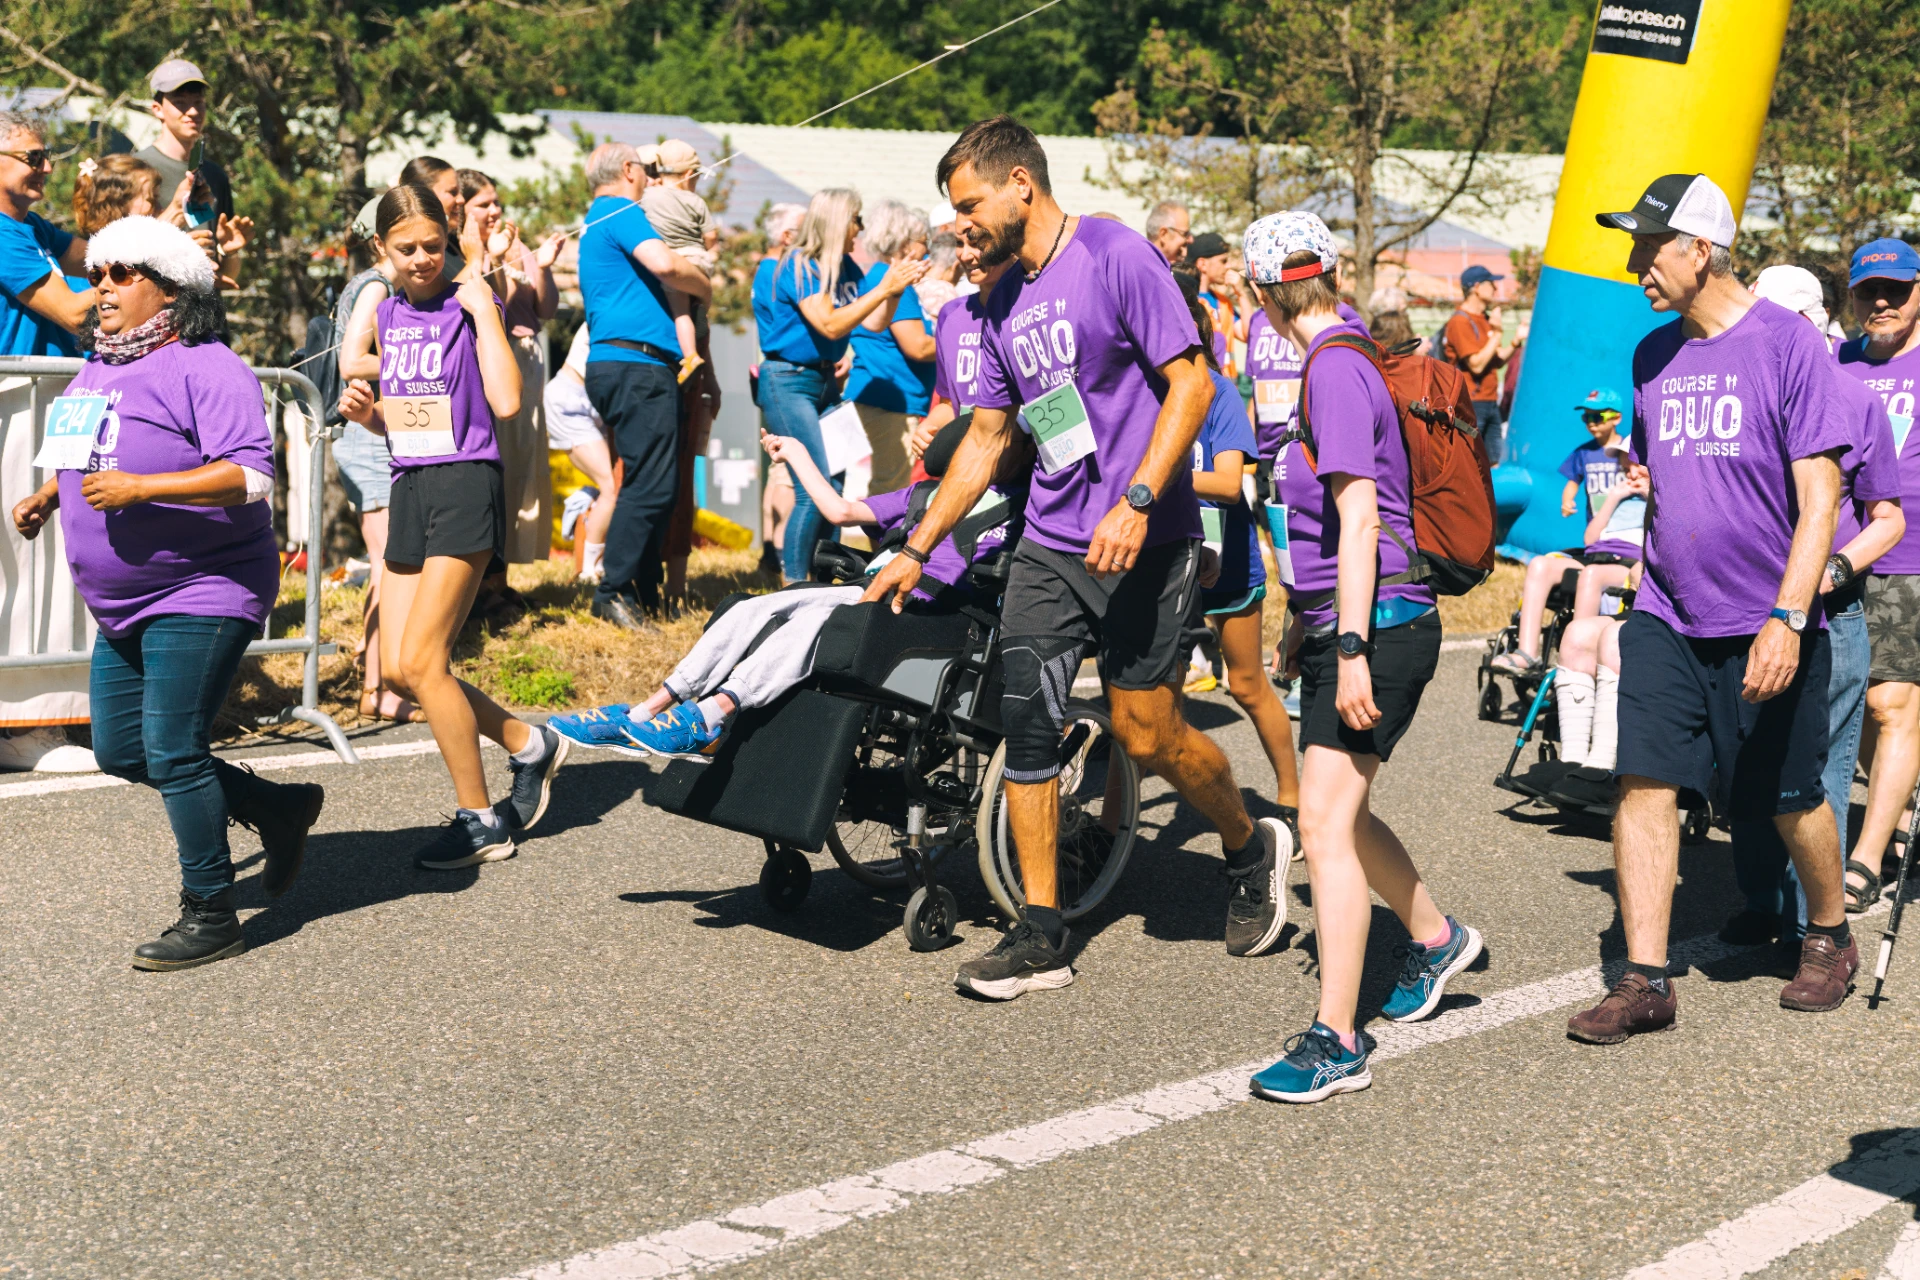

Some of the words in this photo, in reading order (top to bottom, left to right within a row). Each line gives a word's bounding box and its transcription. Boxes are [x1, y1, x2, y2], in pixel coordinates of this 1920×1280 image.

[1645, 194, 1669, 211] Thierry
[1861, 252, 1898, 266] procap
[1012, 301, 1049, 333] COURSE
[382, 342, 442, 380] DUO
[1012, 319, 1076, 379] DUO
[405, 380, 446, 394] SUISSE
[1265, 383, 1290, 403] 114
[1661, 374, 1717, 395] COURSE
[54, 403, 93, 434] 214
[403, 401, 438, 427] 35
[1031, 395, 1065, 435] 35
[1658, 394, 1742, 441] DUO
[1695, 441, 1740, 456] SUISSE
[1780, 789, 1800, 799] FILA
[1269, 869, 1277, 903] HOKA
